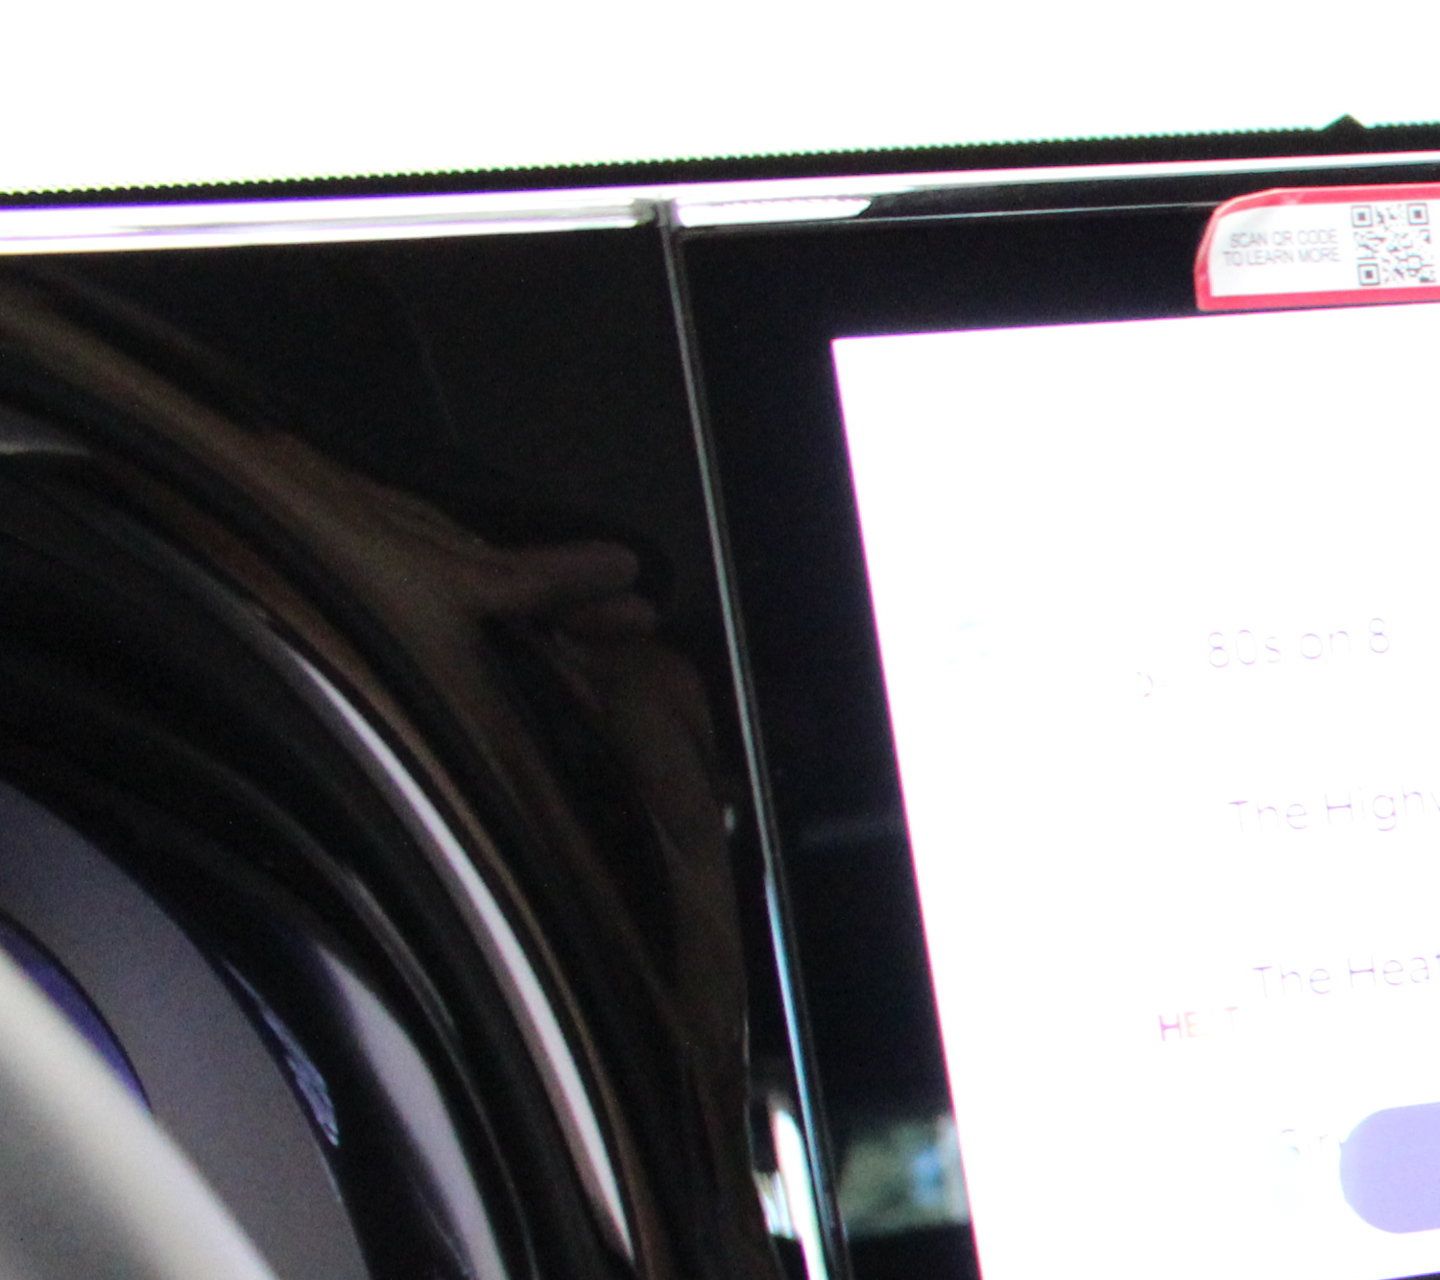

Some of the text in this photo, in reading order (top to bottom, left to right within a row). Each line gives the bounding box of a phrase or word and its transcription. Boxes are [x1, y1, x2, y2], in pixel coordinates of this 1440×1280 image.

[1231, 229, 1268, 248] SCAN
[1299, 229, 1338, 245] CODE
[1223, 247, 1341, 267] TO LEARN MORE
[1206, 615, 1391, 670] 80s on 8
[1226, 798, 1309, 833] The
[1250, 961, 1332, 998] The
[1156, 1003, 1240, 1042] HET
